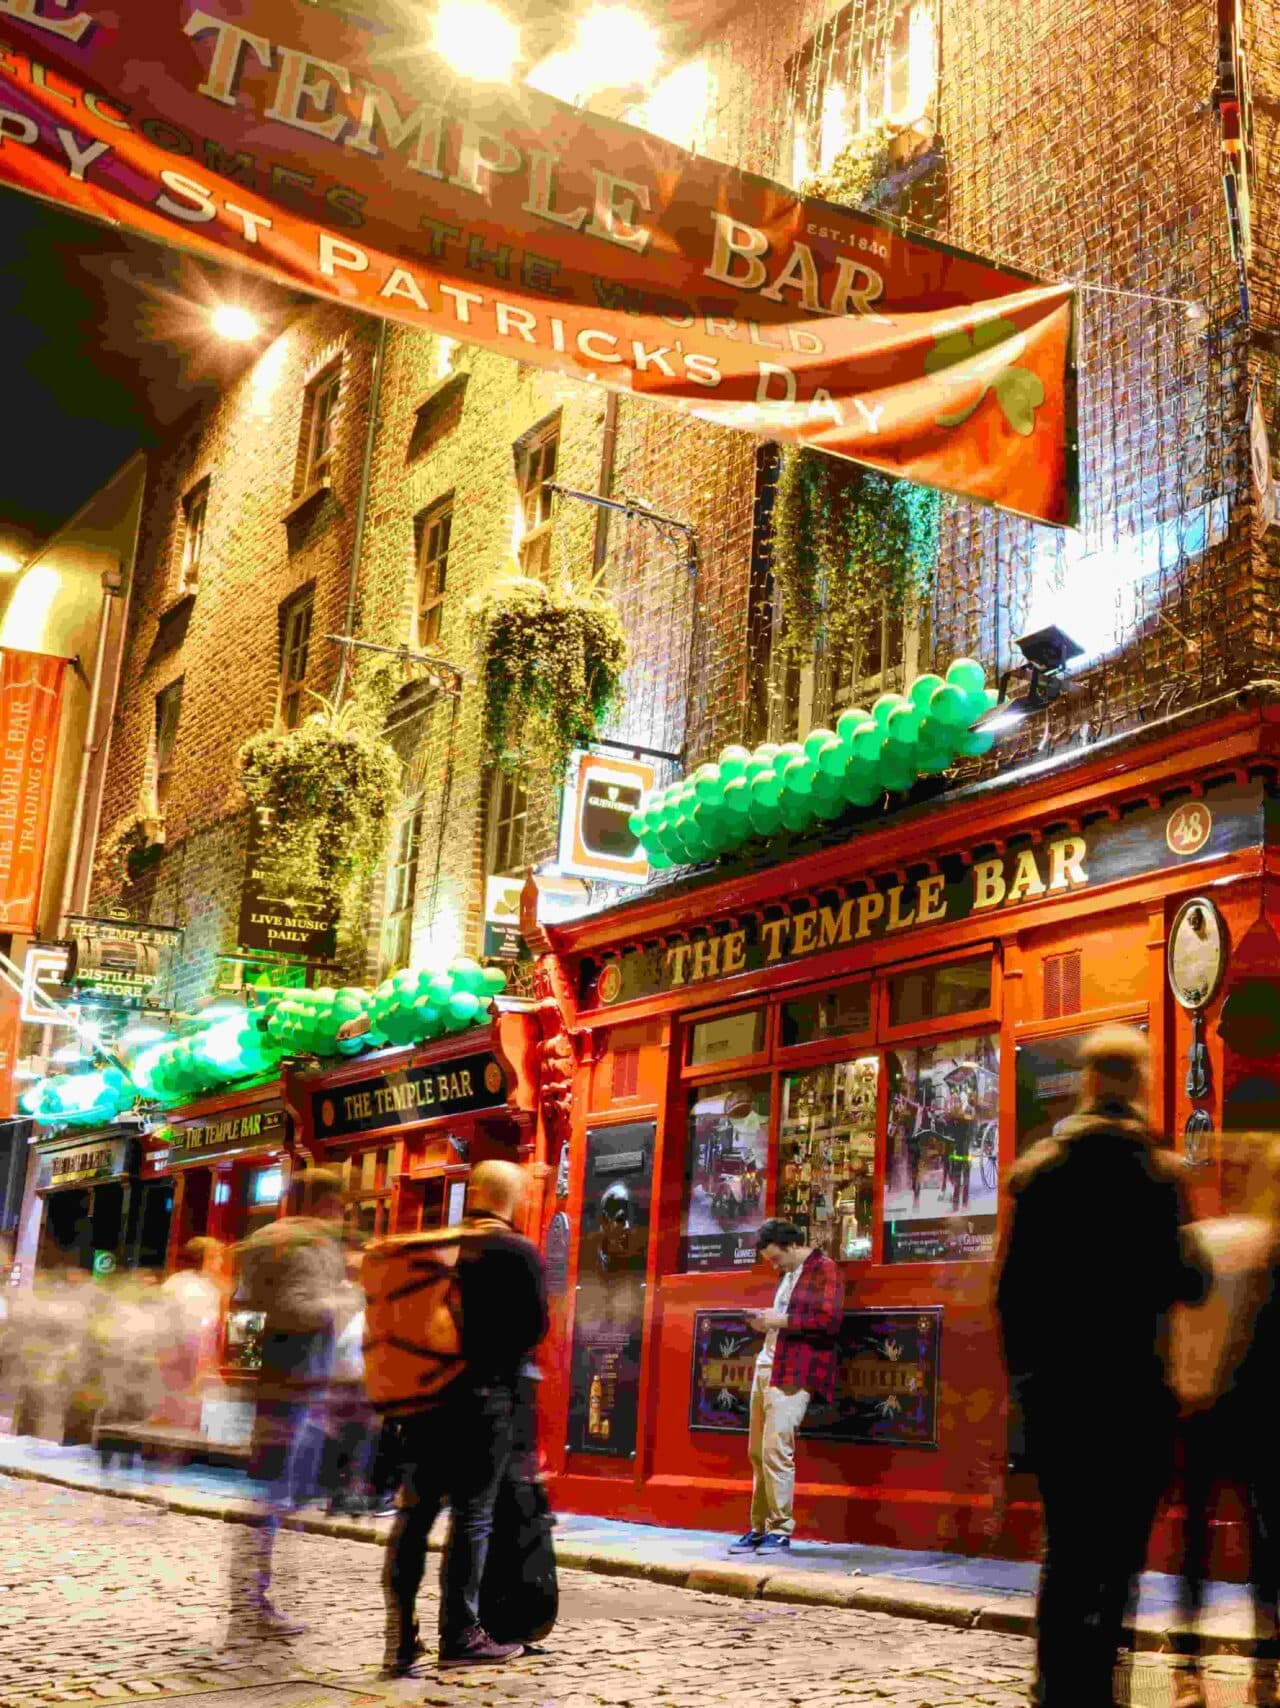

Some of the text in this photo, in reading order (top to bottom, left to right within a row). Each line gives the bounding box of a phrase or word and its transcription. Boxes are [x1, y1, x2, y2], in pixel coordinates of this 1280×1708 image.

[184, 9, 650, 253] TEMPLE
[703, 211, 897, 326] BAR
[421, 216, 562, 293] THE
[156, 171, 272, 243] ST
[319, 234, 723, 388] PATRICK'S
[754, 360, 886, 434] DAY
[8, 700, 30, 743] BAR
[19, 769, 42, 853] TRADING
[1173, 811, 1203, 846] 48
[250, 913, 328, 931] LIVE MUSIC
[666, 836, 1089, 985] THE TEMPLE BAR
[70, 923, 178, 946] THE TEMPLE BAR
[267, 929, 310, 942] DAILY
[78, 968, 162, 985] DISTILLERY
[95, 983, 143, 997] STORE
[343, 1069, 474, 1121] THE TEMPLE BAR
[185, 1127, 203, 1149] THE
[205, 1119, 240, 1145] TEMPLE
[240, 1114, 262, 1138] BAR
